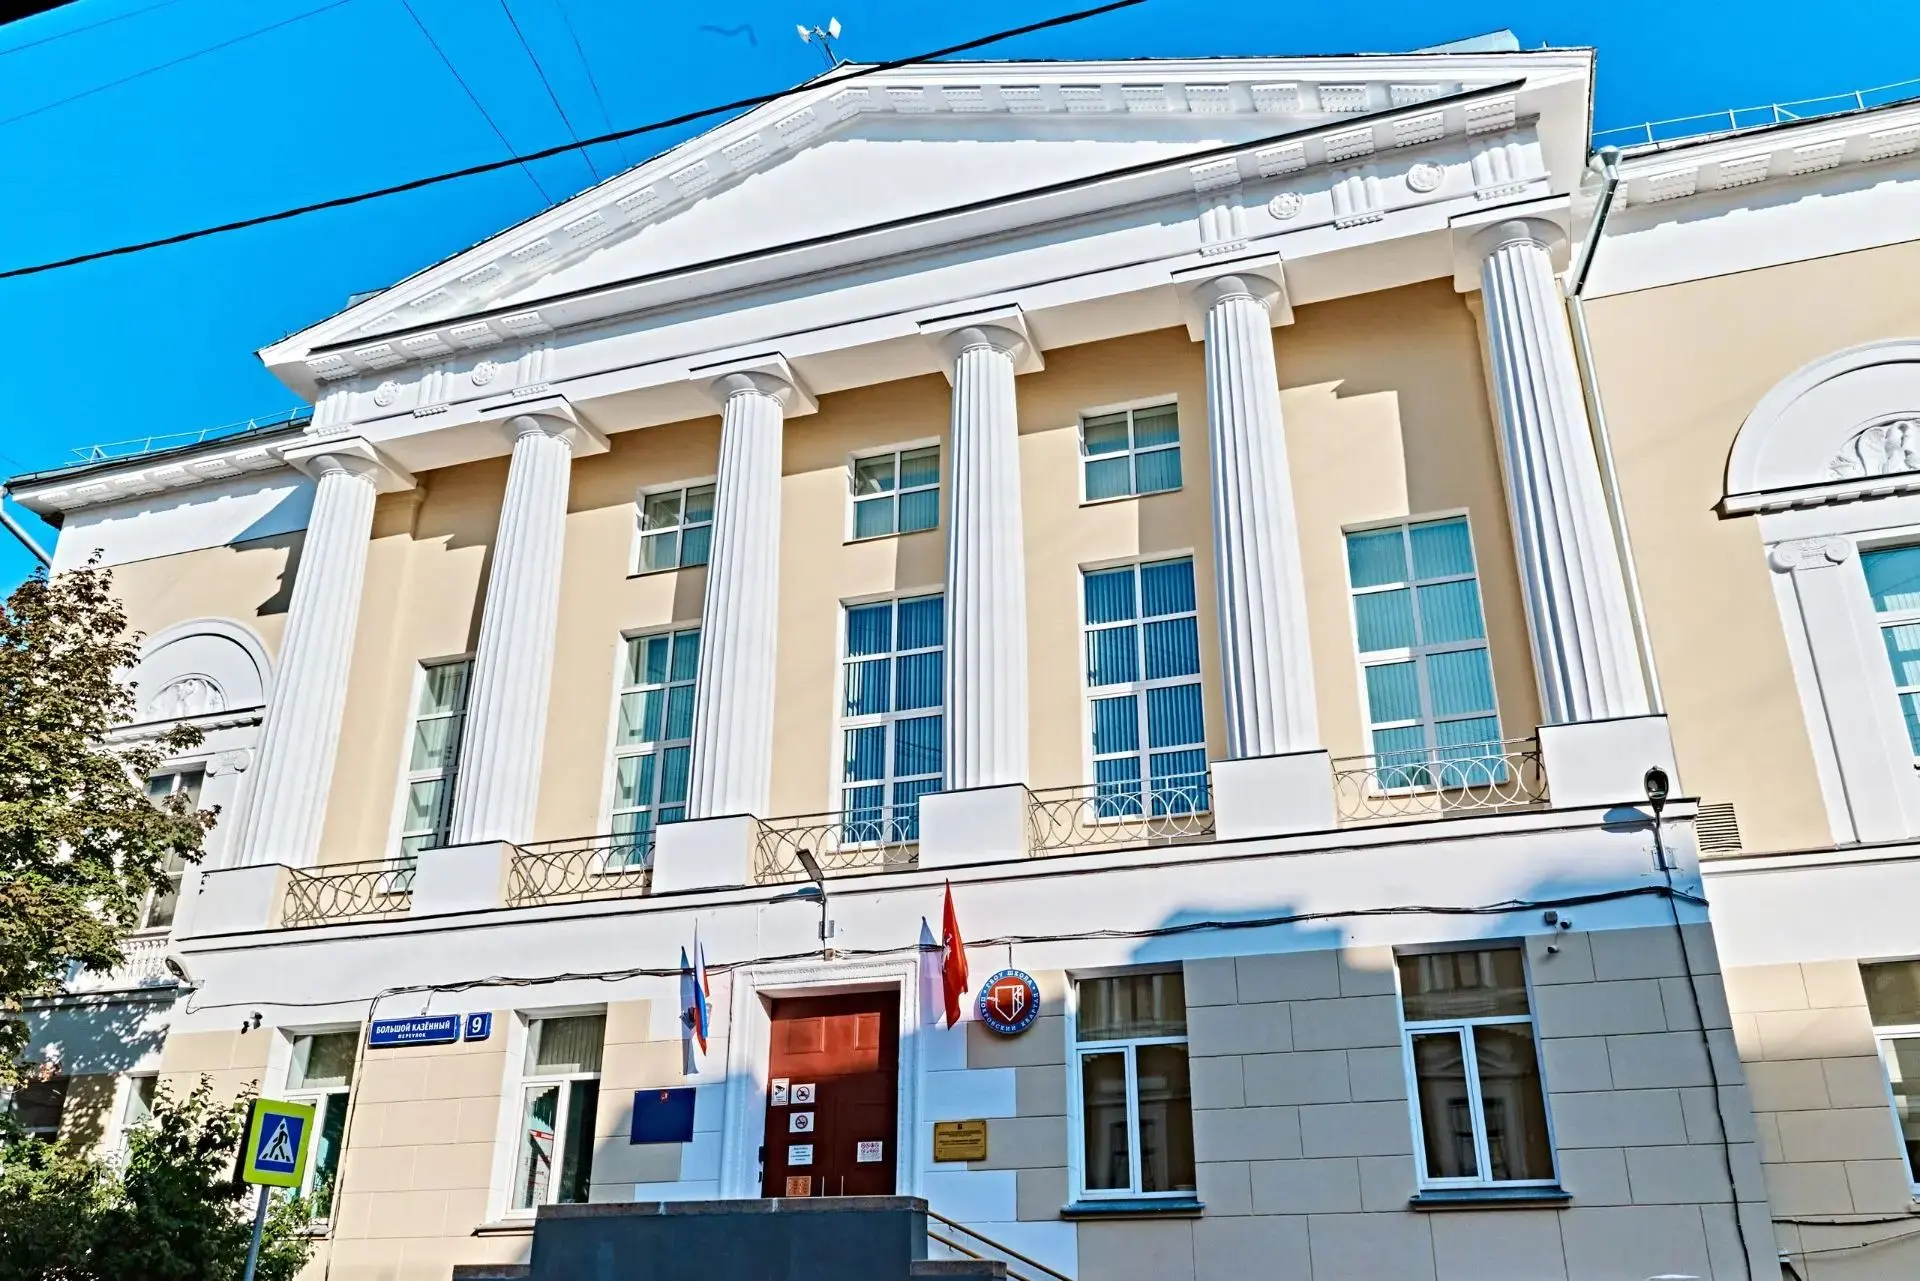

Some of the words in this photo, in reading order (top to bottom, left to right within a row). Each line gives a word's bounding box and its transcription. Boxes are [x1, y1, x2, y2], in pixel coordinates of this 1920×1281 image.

[1007, 970, 1032, 985] ШКОЛА
[376, 1022, 411, 1034] БОЛЬШОЙ
[411, 1020, 451, 1031] КАЗЁННЫЙ
[472, 1016, 482, 1034] 9
